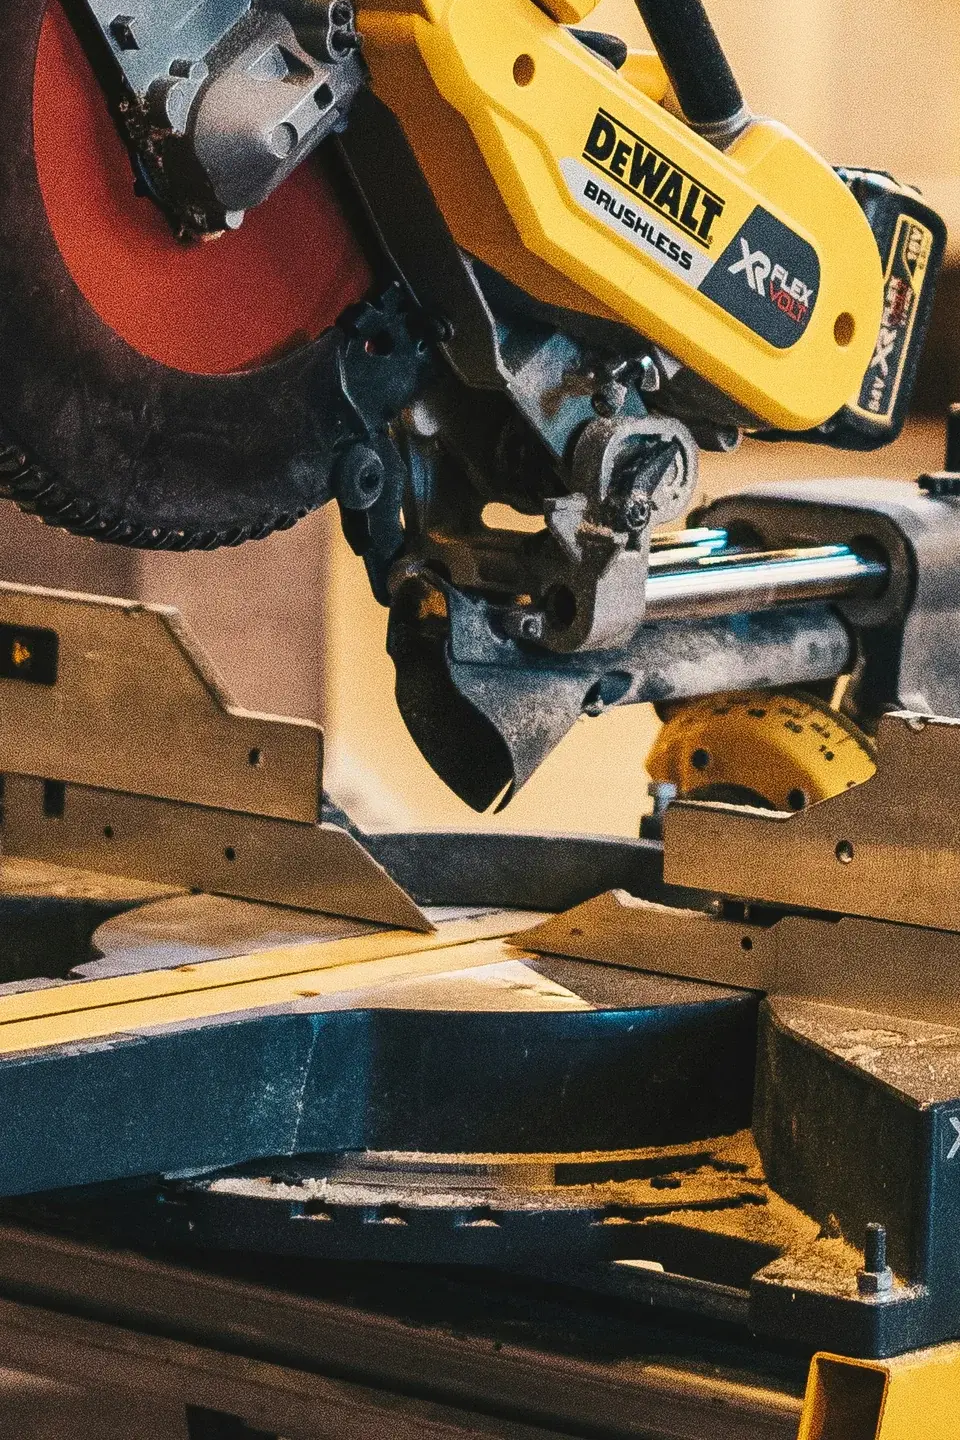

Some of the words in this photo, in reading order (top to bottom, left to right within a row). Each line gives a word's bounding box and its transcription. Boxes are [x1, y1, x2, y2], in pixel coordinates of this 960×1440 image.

[583, 179, 693, 271] BRUSHLESS
[727, 237, 771, 297] XR
[769, 263, 814, 308] FLEX
[768, 280, 808, 323] VOLT
